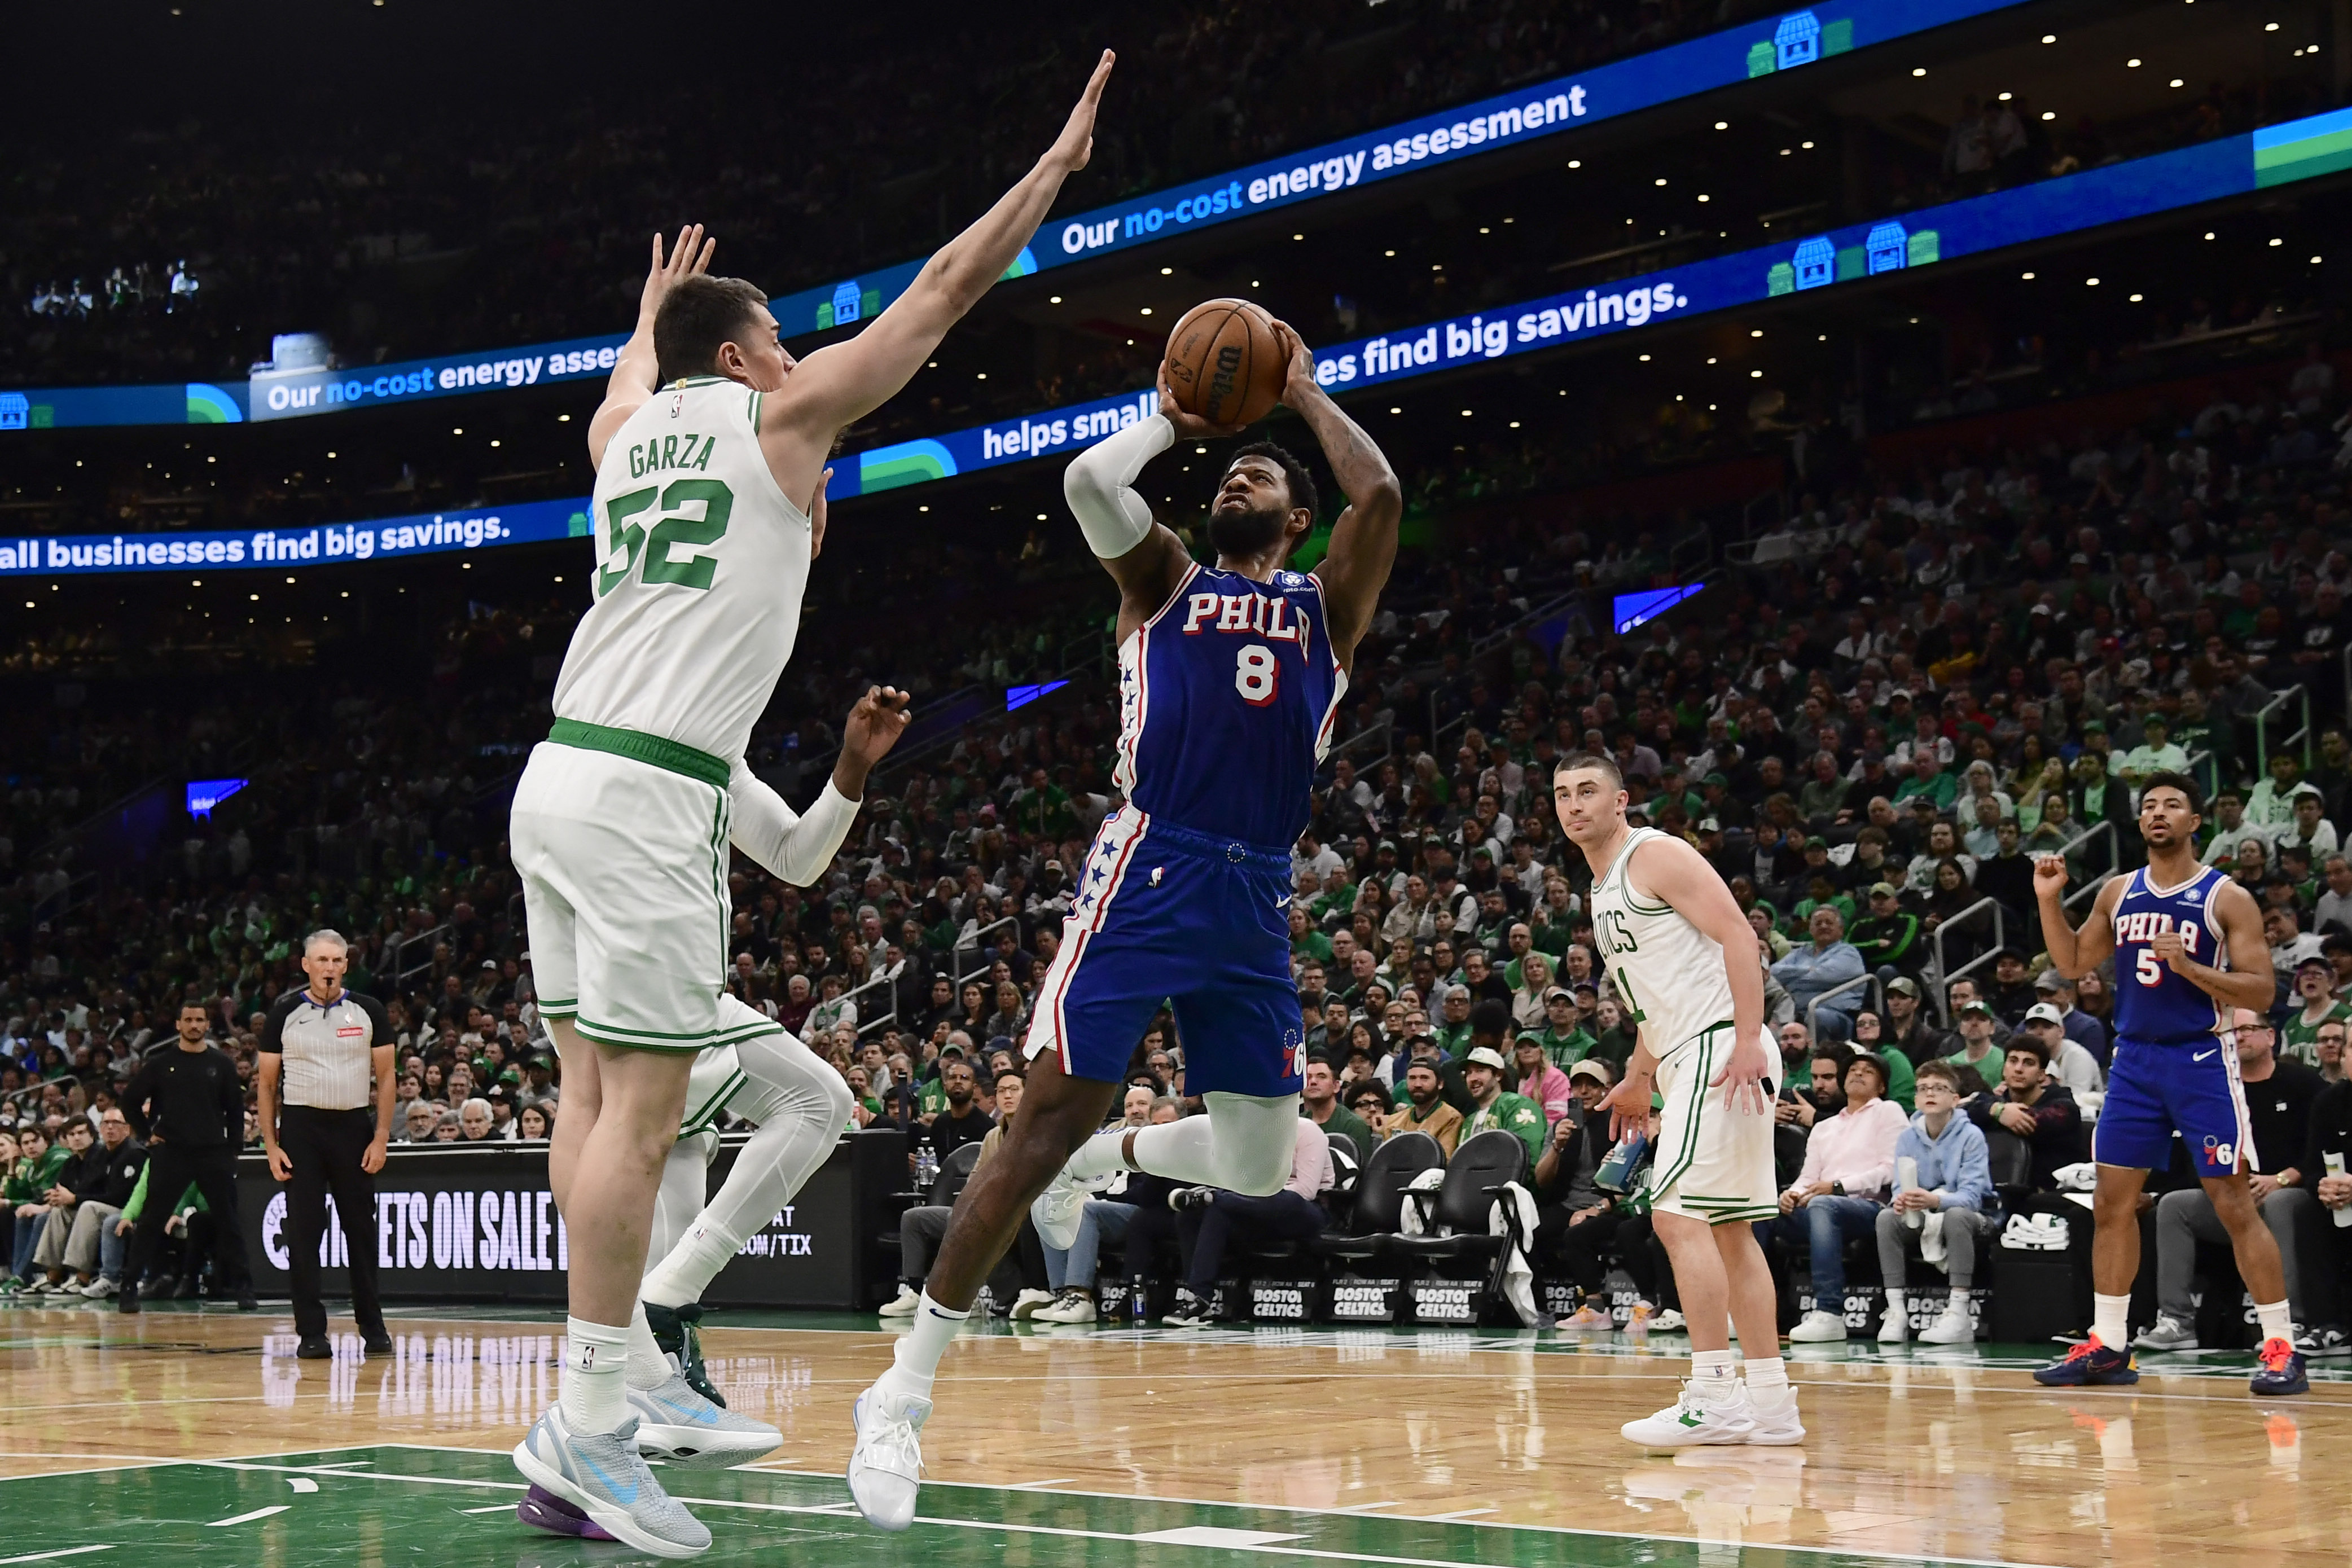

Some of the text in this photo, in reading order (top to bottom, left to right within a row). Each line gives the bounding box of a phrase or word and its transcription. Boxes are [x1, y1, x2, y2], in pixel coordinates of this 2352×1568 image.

[1063, 86, 1586, 253] Our no-cost energy assessment
[268, 382, 322, 411] Our
[326, 367, 435, 404] no-cost
[440, 357, 543, 389] energy
[984, 421, 1067, 459] helps
[1073, 390, 1159, 440] small
[1363, 328, 1437, 376] find
[1447, 317, 1508, 358] big
[1517, 284, 1687, 342] savings.
[629, 433, 716, 480] GARZA
[48, 537, 244, 567] businesses
[252, 530, 318, 561] find
[326, 525, 374, 559] big
[381, 516, 510, 551] savings.
[598, 478, 734, 598] 52
[1183, 592, 1311, 666] PHILA
[1236, 644, 1279, 706] 8
[2136, 948, 2164, 987] 5
[1282, 1042, 1304, 1078] 76
[2204, 1143, 2233, 1166] 76
[433, 1191, 474, 1270] ON
[479, 1190, 552, 1271] SALE
[772, 1206, 795, 1227] AT
[1253, 1303, 1303, 1317] CELTICS
[1334, 1302, 1386, 1316] CELTICS
[1416, 1303, 1470, 1318] CELTICS
